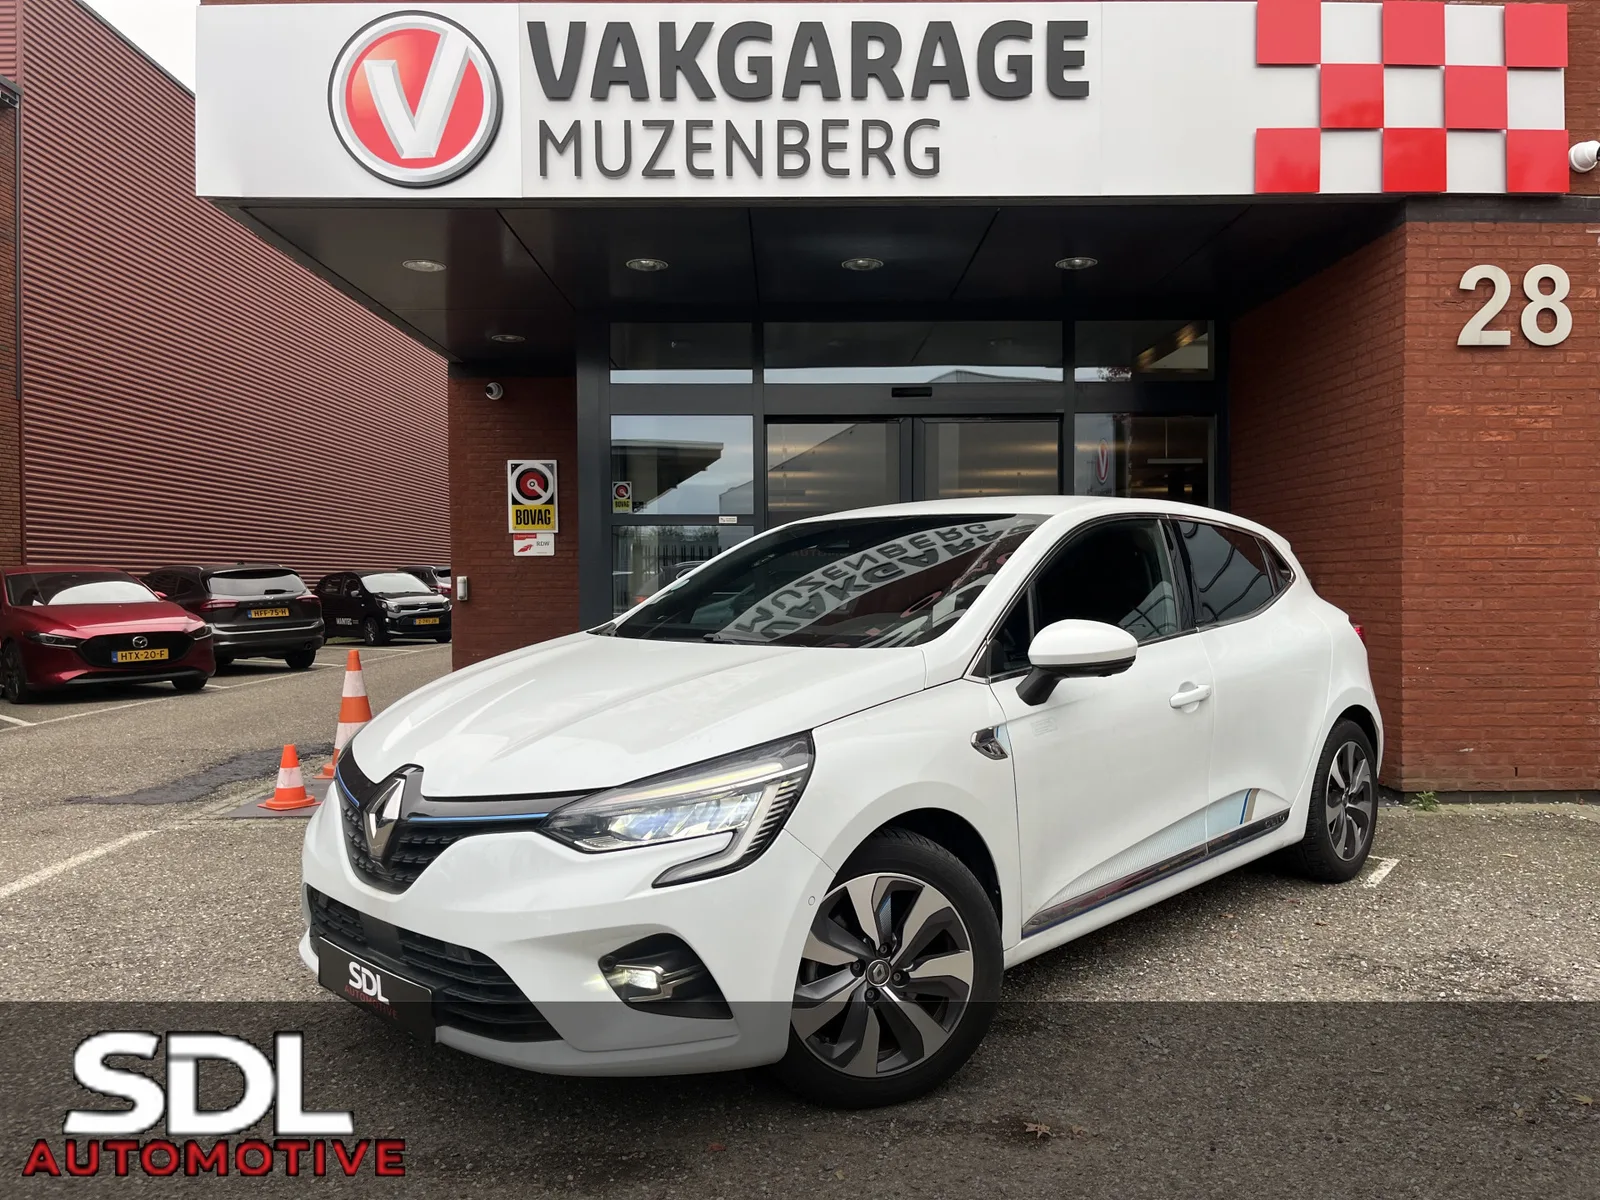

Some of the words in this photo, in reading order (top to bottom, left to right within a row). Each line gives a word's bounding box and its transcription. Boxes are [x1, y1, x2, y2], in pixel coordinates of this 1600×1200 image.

[527, 20, 1089, 101] VAKGARAGE
[539, 118, 940, 179] MUZENBERG
[1457, 264, 1573, 346] 28
[515, 509, 551, 526] BOVAG
[120, 650, 165, 661] HTX-20-F
[344, 984, 400, 1020] AUTOMOTIVE
[348, 961, 390, 1005] SDL
